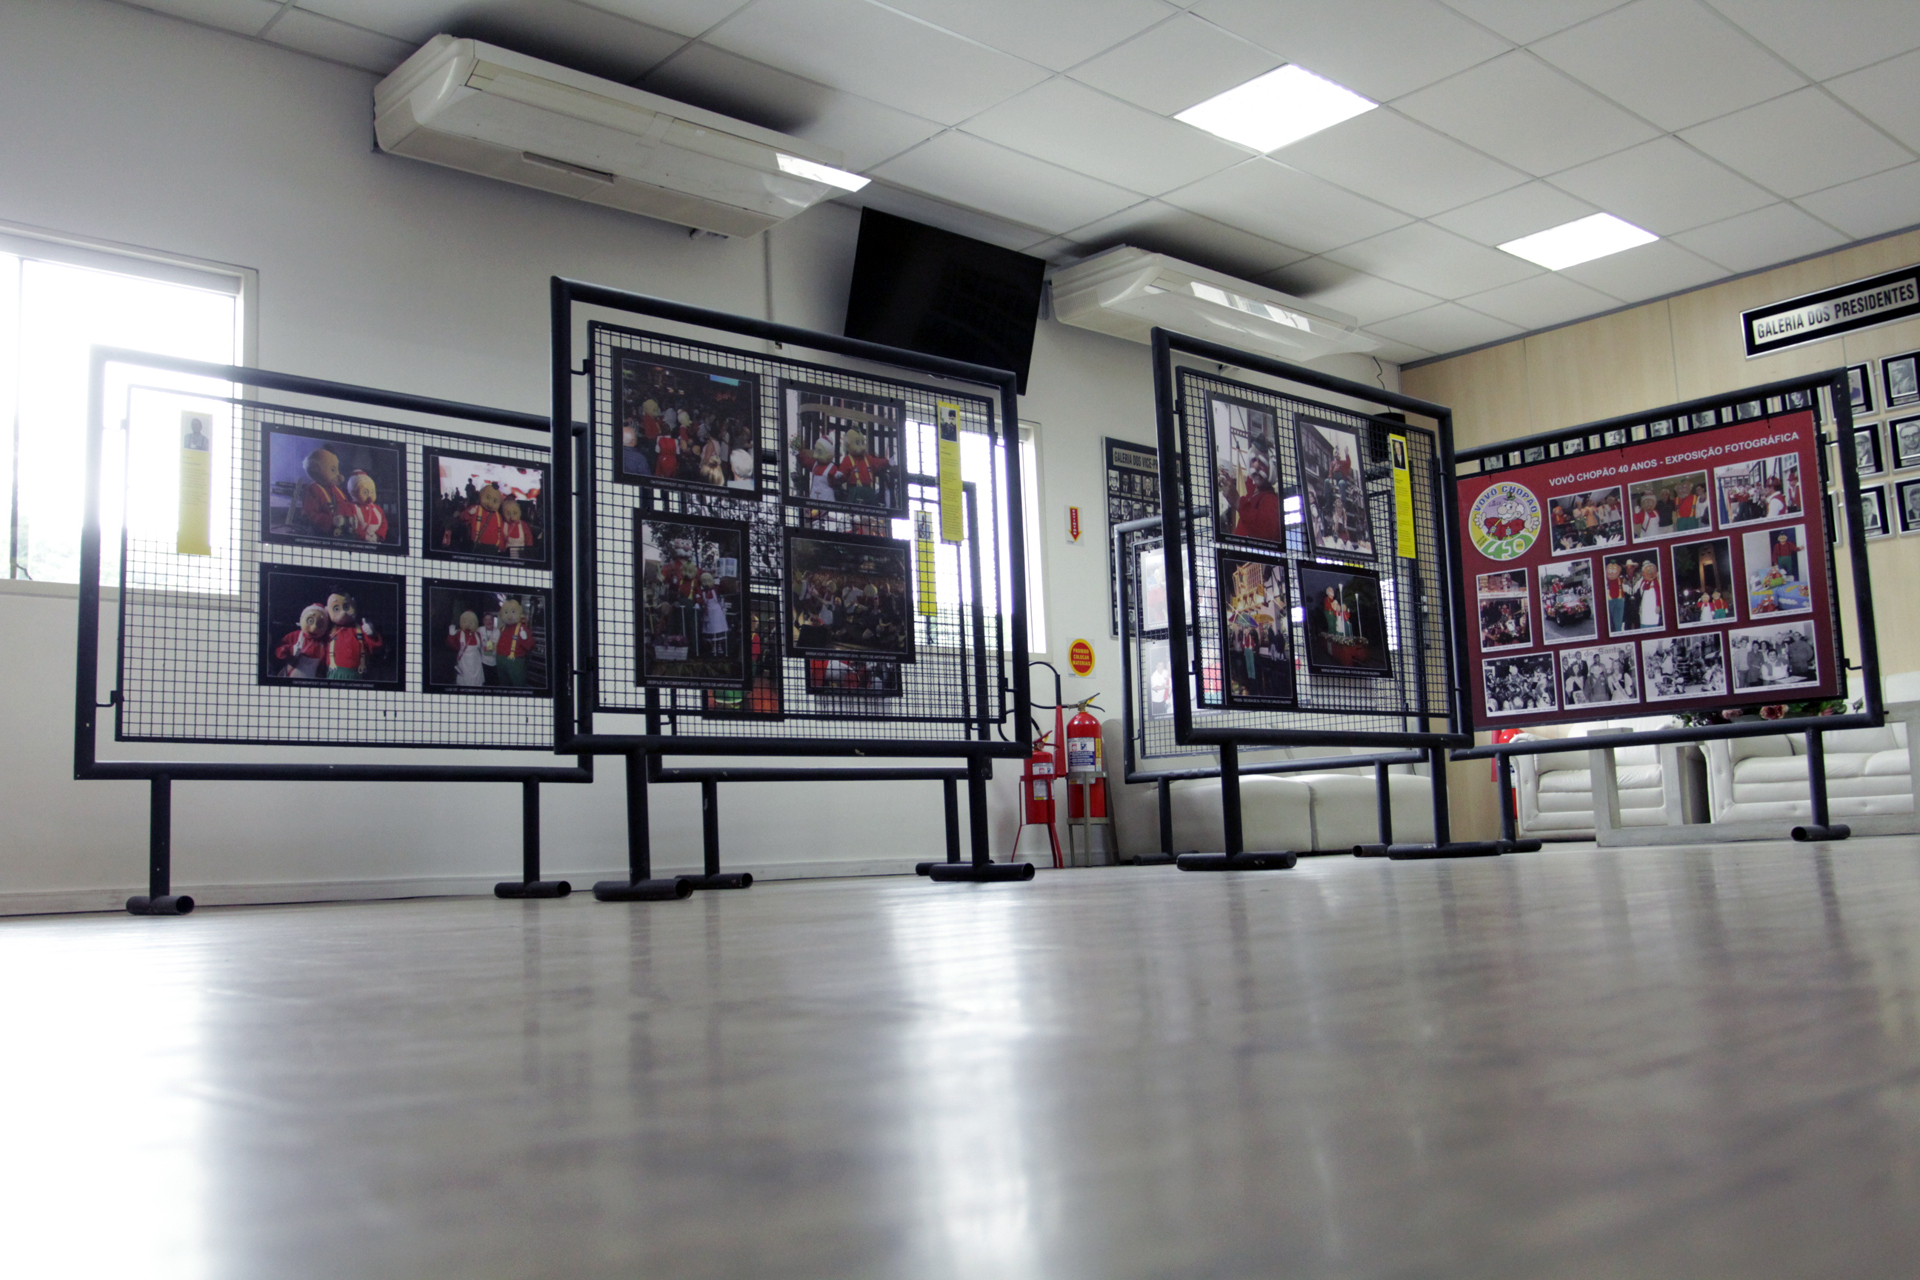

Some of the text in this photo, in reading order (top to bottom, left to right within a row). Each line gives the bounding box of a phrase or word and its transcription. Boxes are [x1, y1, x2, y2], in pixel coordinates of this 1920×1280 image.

[1757, 284, 1915, 338] GALERIA DOS PRESIDENTES
[1114, 451, 1132, 465] GALERIA
[1549, 474, 1575, 486] VOVÔ
[1576, 467, 1616, 481] CHOPÃO
[1618, 464, 1629, 473] 40
[1630, 459, 1658, 471] ANOS
[1665, 446, 1722, 465] EXPOSIÇÃO
[1725, 432, 1799, 454] FOTOGRÁFICA
